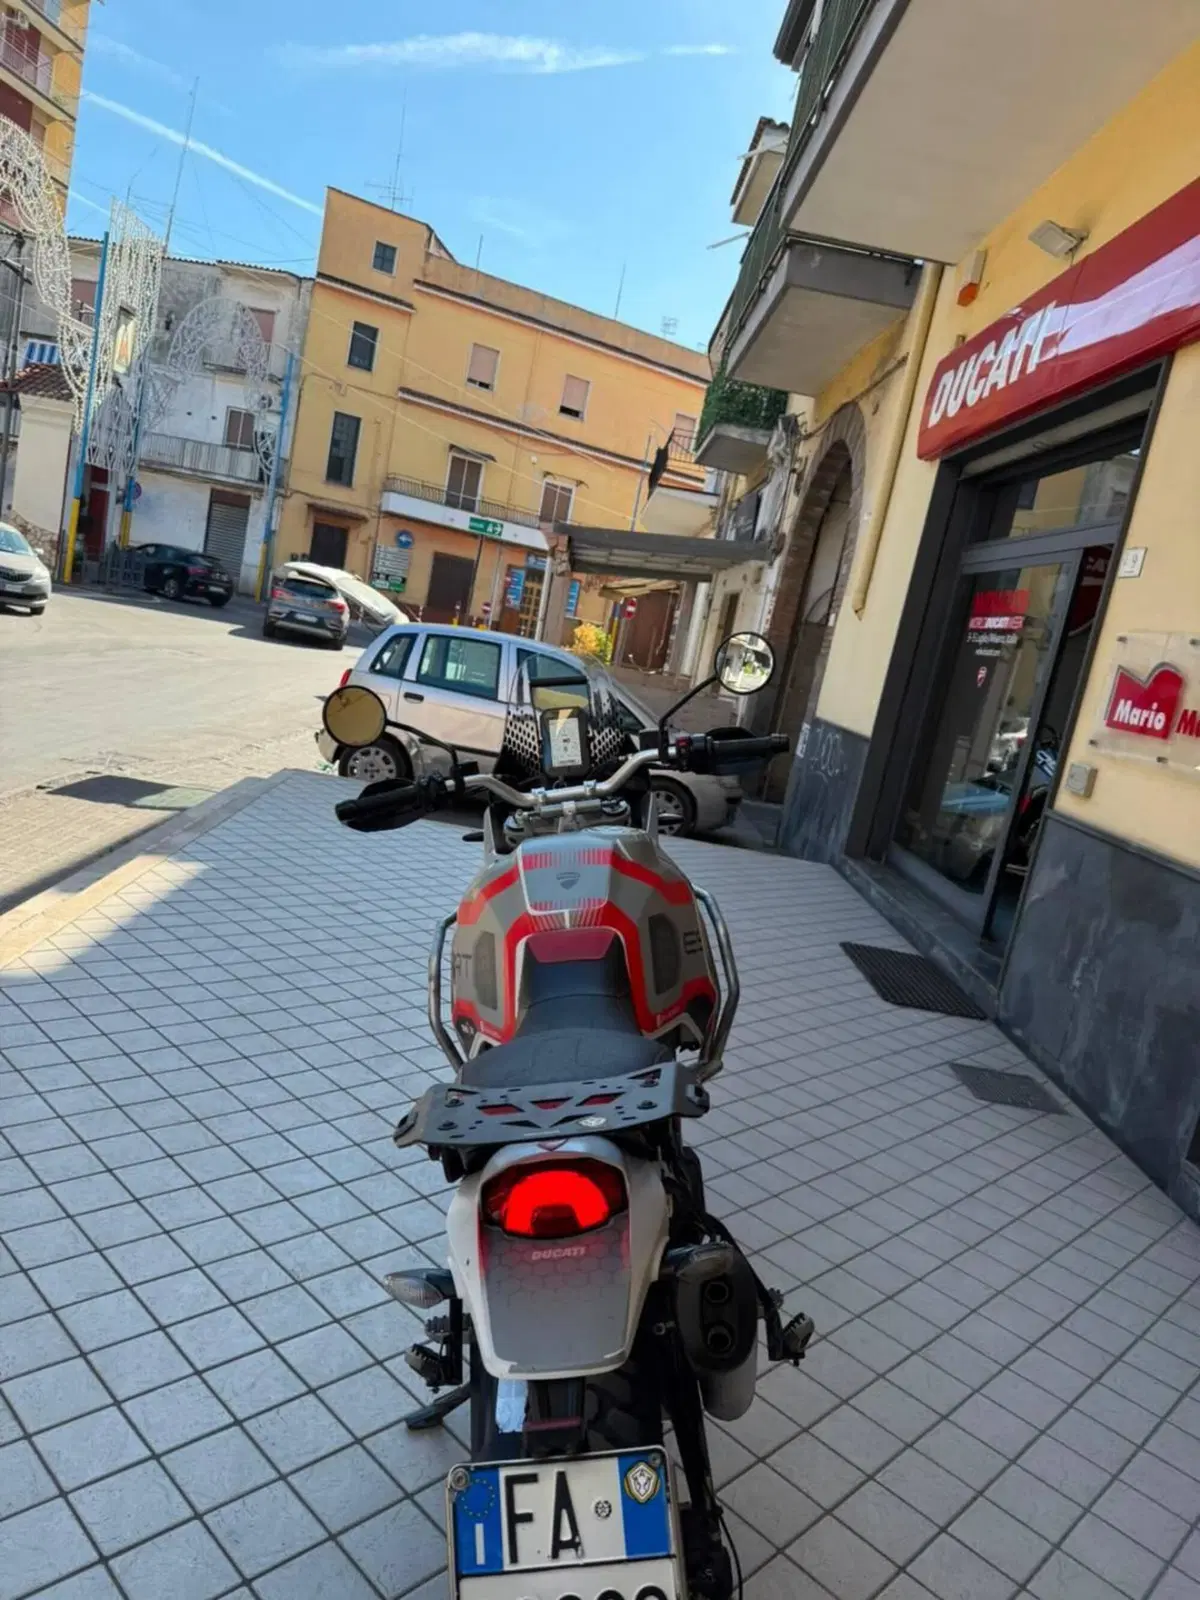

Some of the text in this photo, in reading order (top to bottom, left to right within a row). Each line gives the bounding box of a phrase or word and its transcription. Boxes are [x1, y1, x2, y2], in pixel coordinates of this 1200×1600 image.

[928, 301, 1057, 428] DUCATI
[1113, 698, 1166, 730] Mario
[531, 1246, 586, 1261] DUCATI
[504, 1470, 581, 1564] FA
